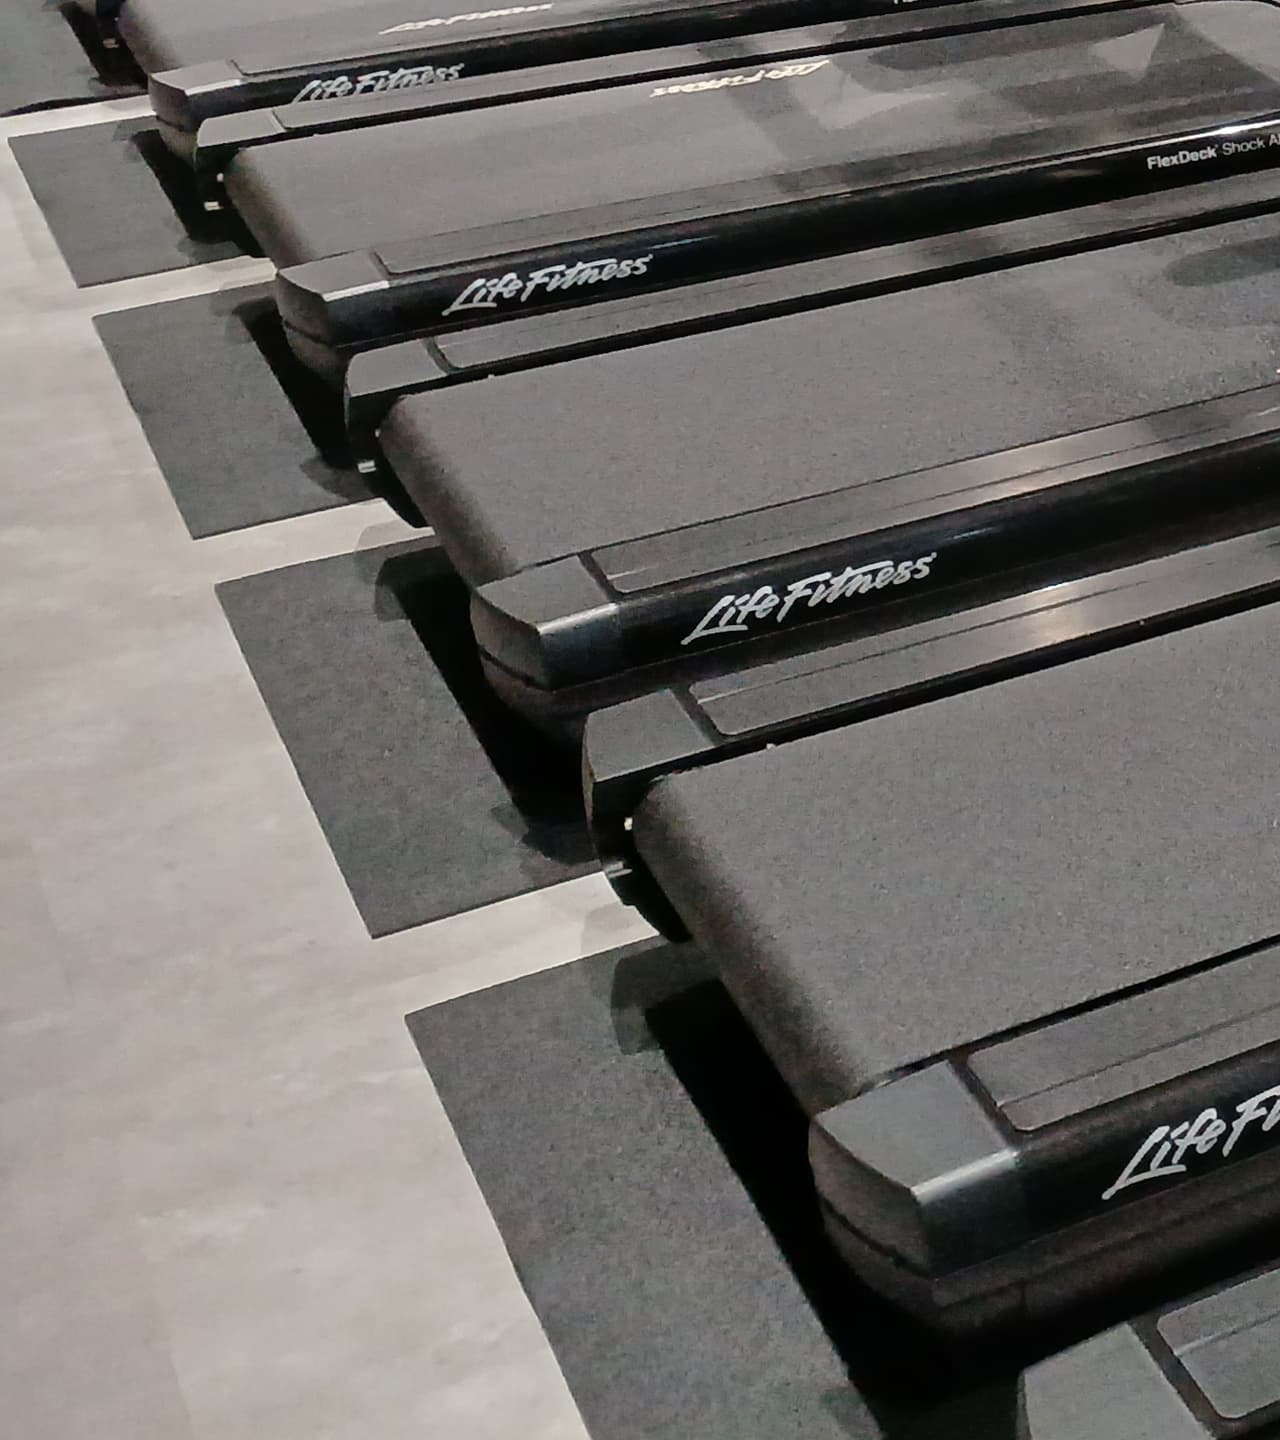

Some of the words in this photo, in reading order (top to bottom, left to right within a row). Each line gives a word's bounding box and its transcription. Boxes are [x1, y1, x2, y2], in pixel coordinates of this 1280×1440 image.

[1222, 137, 1266, 155] Shock
[679, 585, 780, 645] Life
[776, 552, 937, 623] Fitness
[1101, 1108, 1226, 1200] Life
